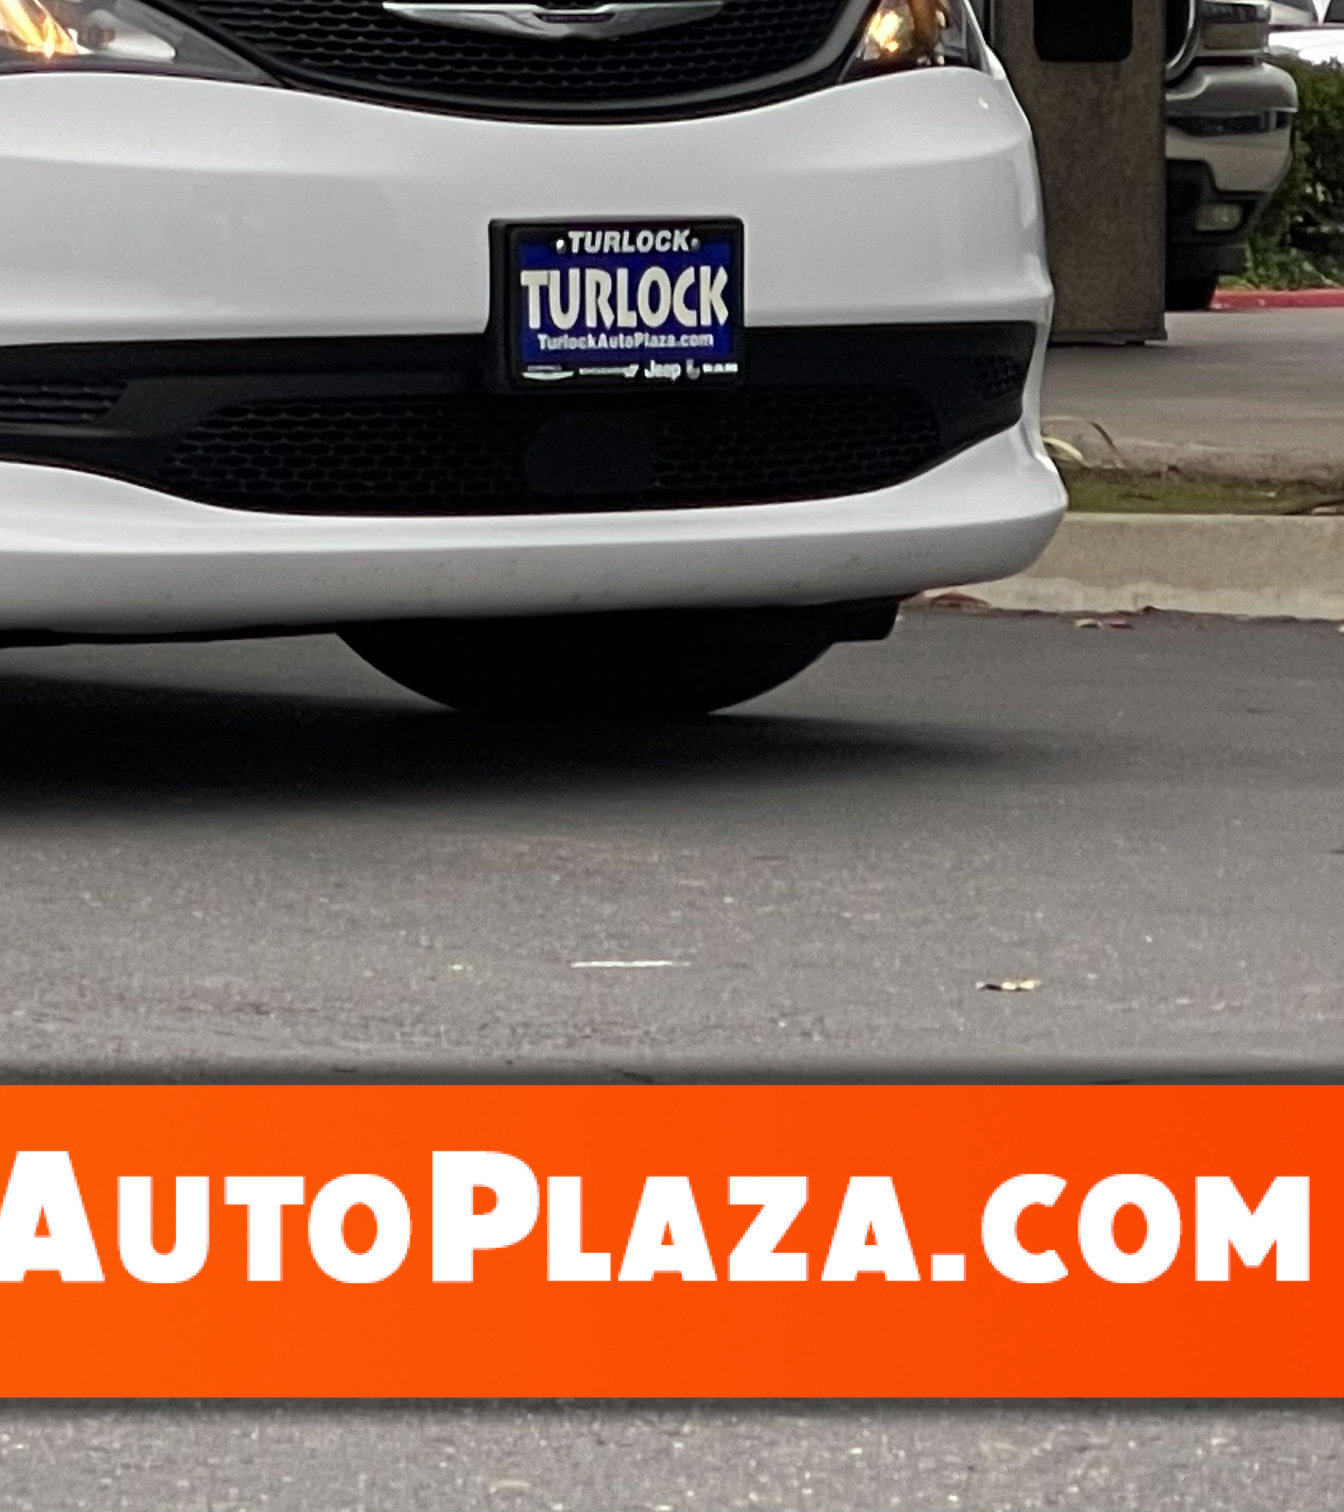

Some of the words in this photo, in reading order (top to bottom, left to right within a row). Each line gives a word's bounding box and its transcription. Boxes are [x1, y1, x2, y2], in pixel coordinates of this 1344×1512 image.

[568, 228, 691, 254] TURLOCK
[520, 265, 730, 330] TURLOCK
[537, 332, 715, 350] TurlockAutoPlaza.com
